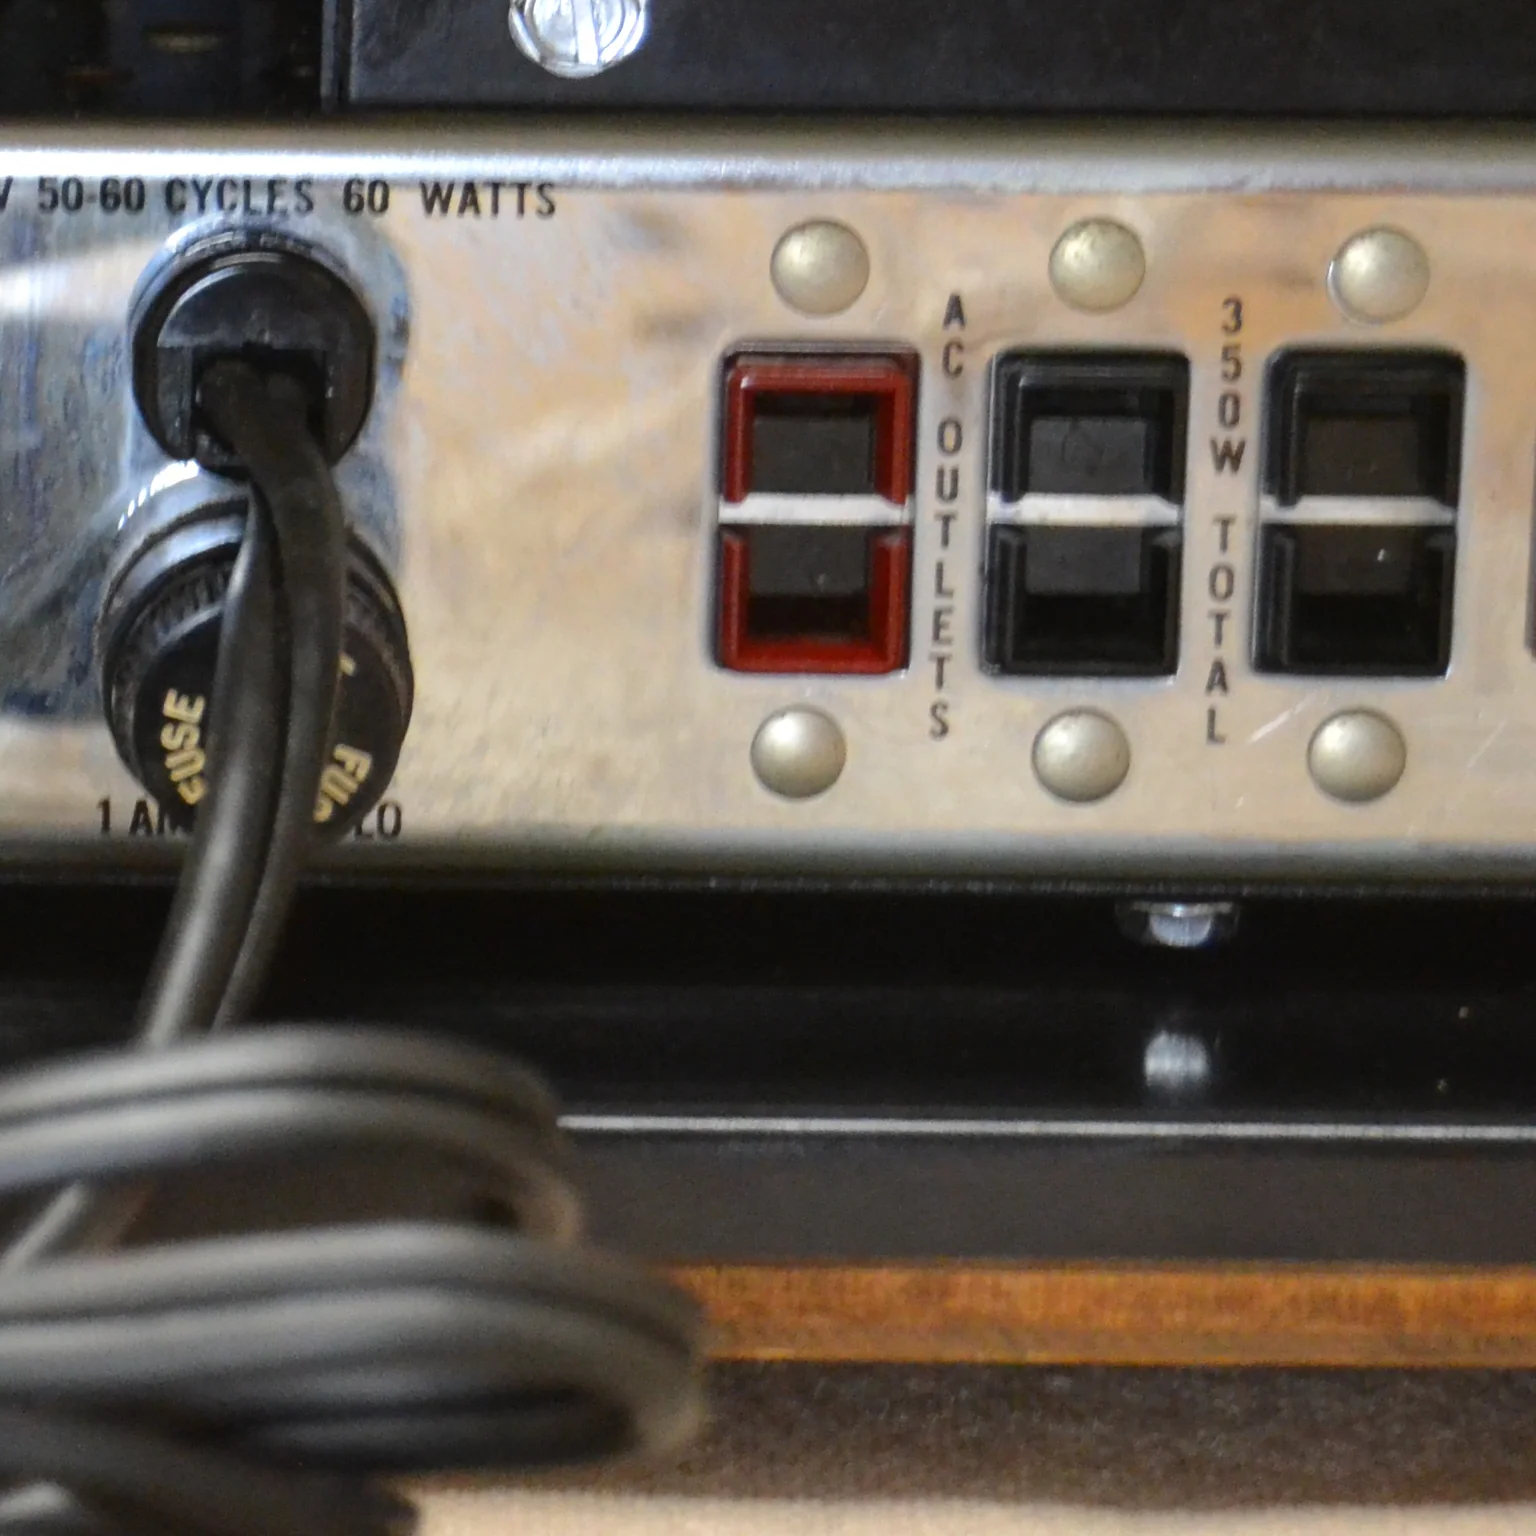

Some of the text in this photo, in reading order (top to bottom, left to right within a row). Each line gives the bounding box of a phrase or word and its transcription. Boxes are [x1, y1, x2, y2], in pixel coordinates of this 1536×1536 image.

[164, 179, 316, 214] CYCLES
[342, 180, 390, 214] 60
[419, 179, 558, 217] WATTS
